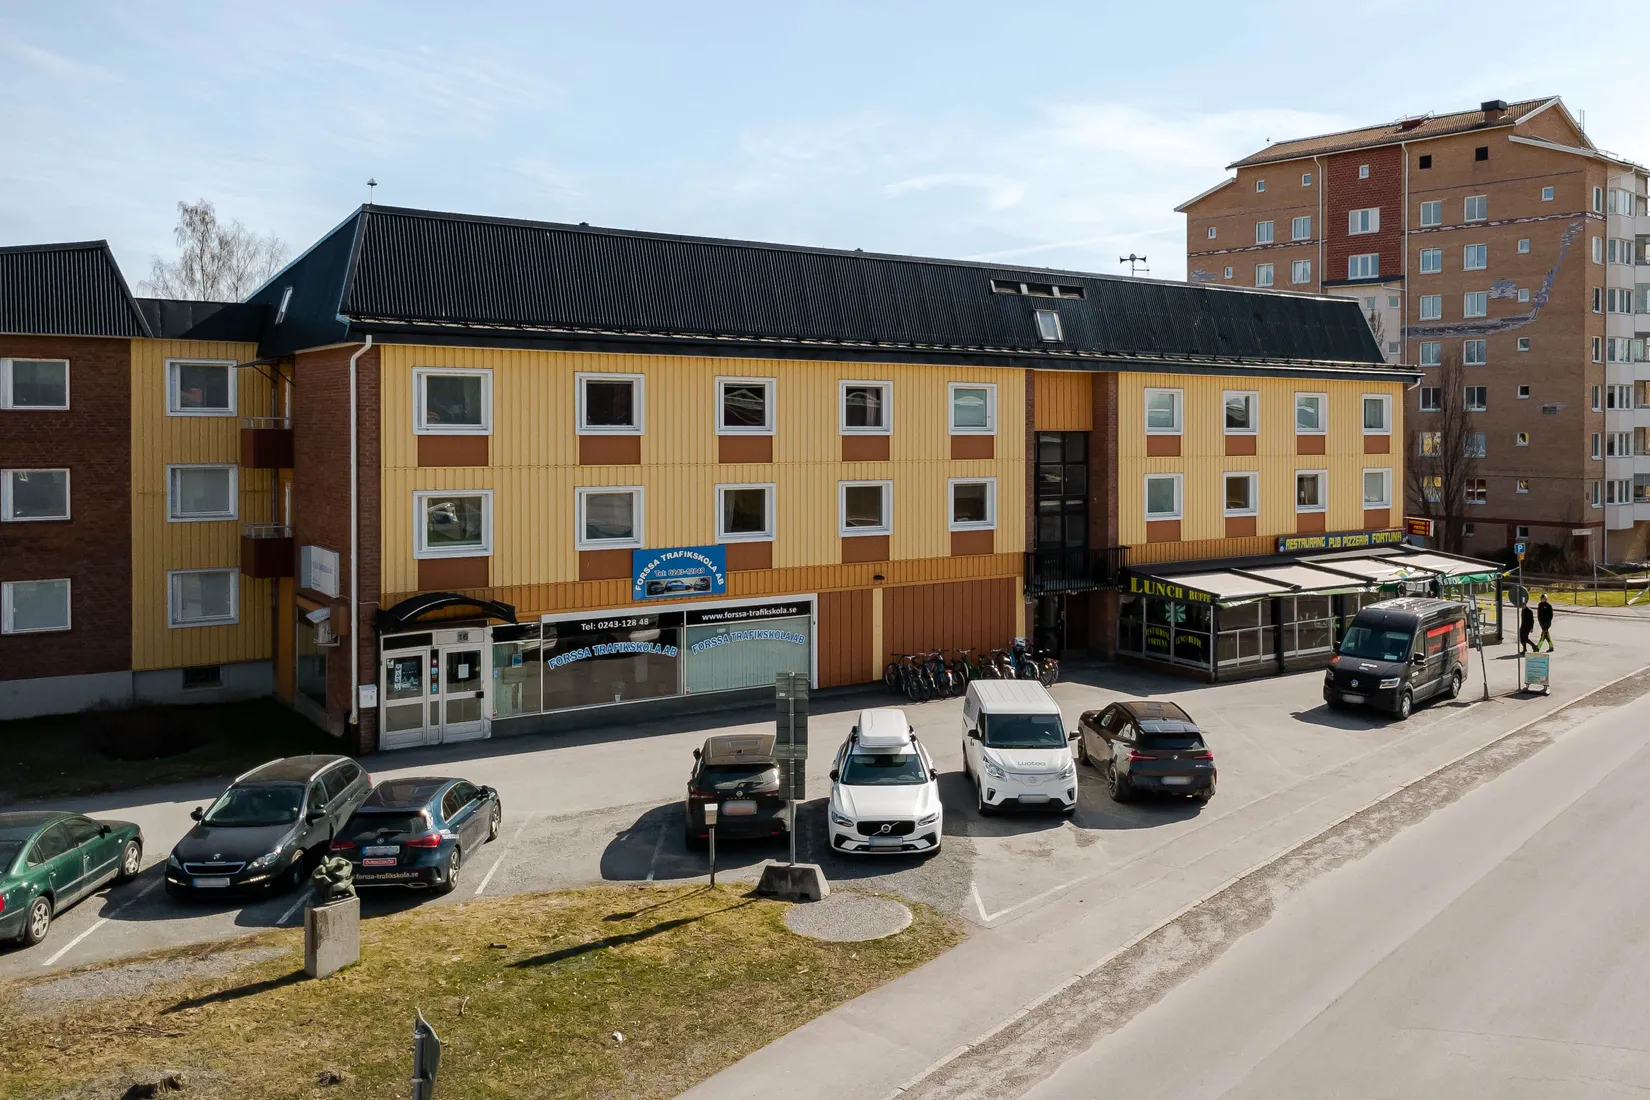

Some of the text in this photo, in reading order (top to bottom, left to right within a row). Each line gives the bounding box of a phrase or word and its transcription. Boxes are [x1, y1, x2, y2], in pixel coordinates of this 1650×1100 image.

[1285, 531, 1402, 550] RESTAURANG PUB PIZZERIA FORTUNA
[635, 550, 725, 591] FORSSA TRAFIKSKOLA AB
[1130, 576, 1183, 599] LUNCH
[581, 617, 649, 631] Tel: 0243-128 48
[702, 606, 798, 621] www.forssa-trafikskola.se
[458, 633, 468, 641] 16
[692, 629, 805, 655] FORSSA TRAFIKSKOLA AB
[548, 641, 678, 669] FORSSA TRAFIKSKOLA AB
